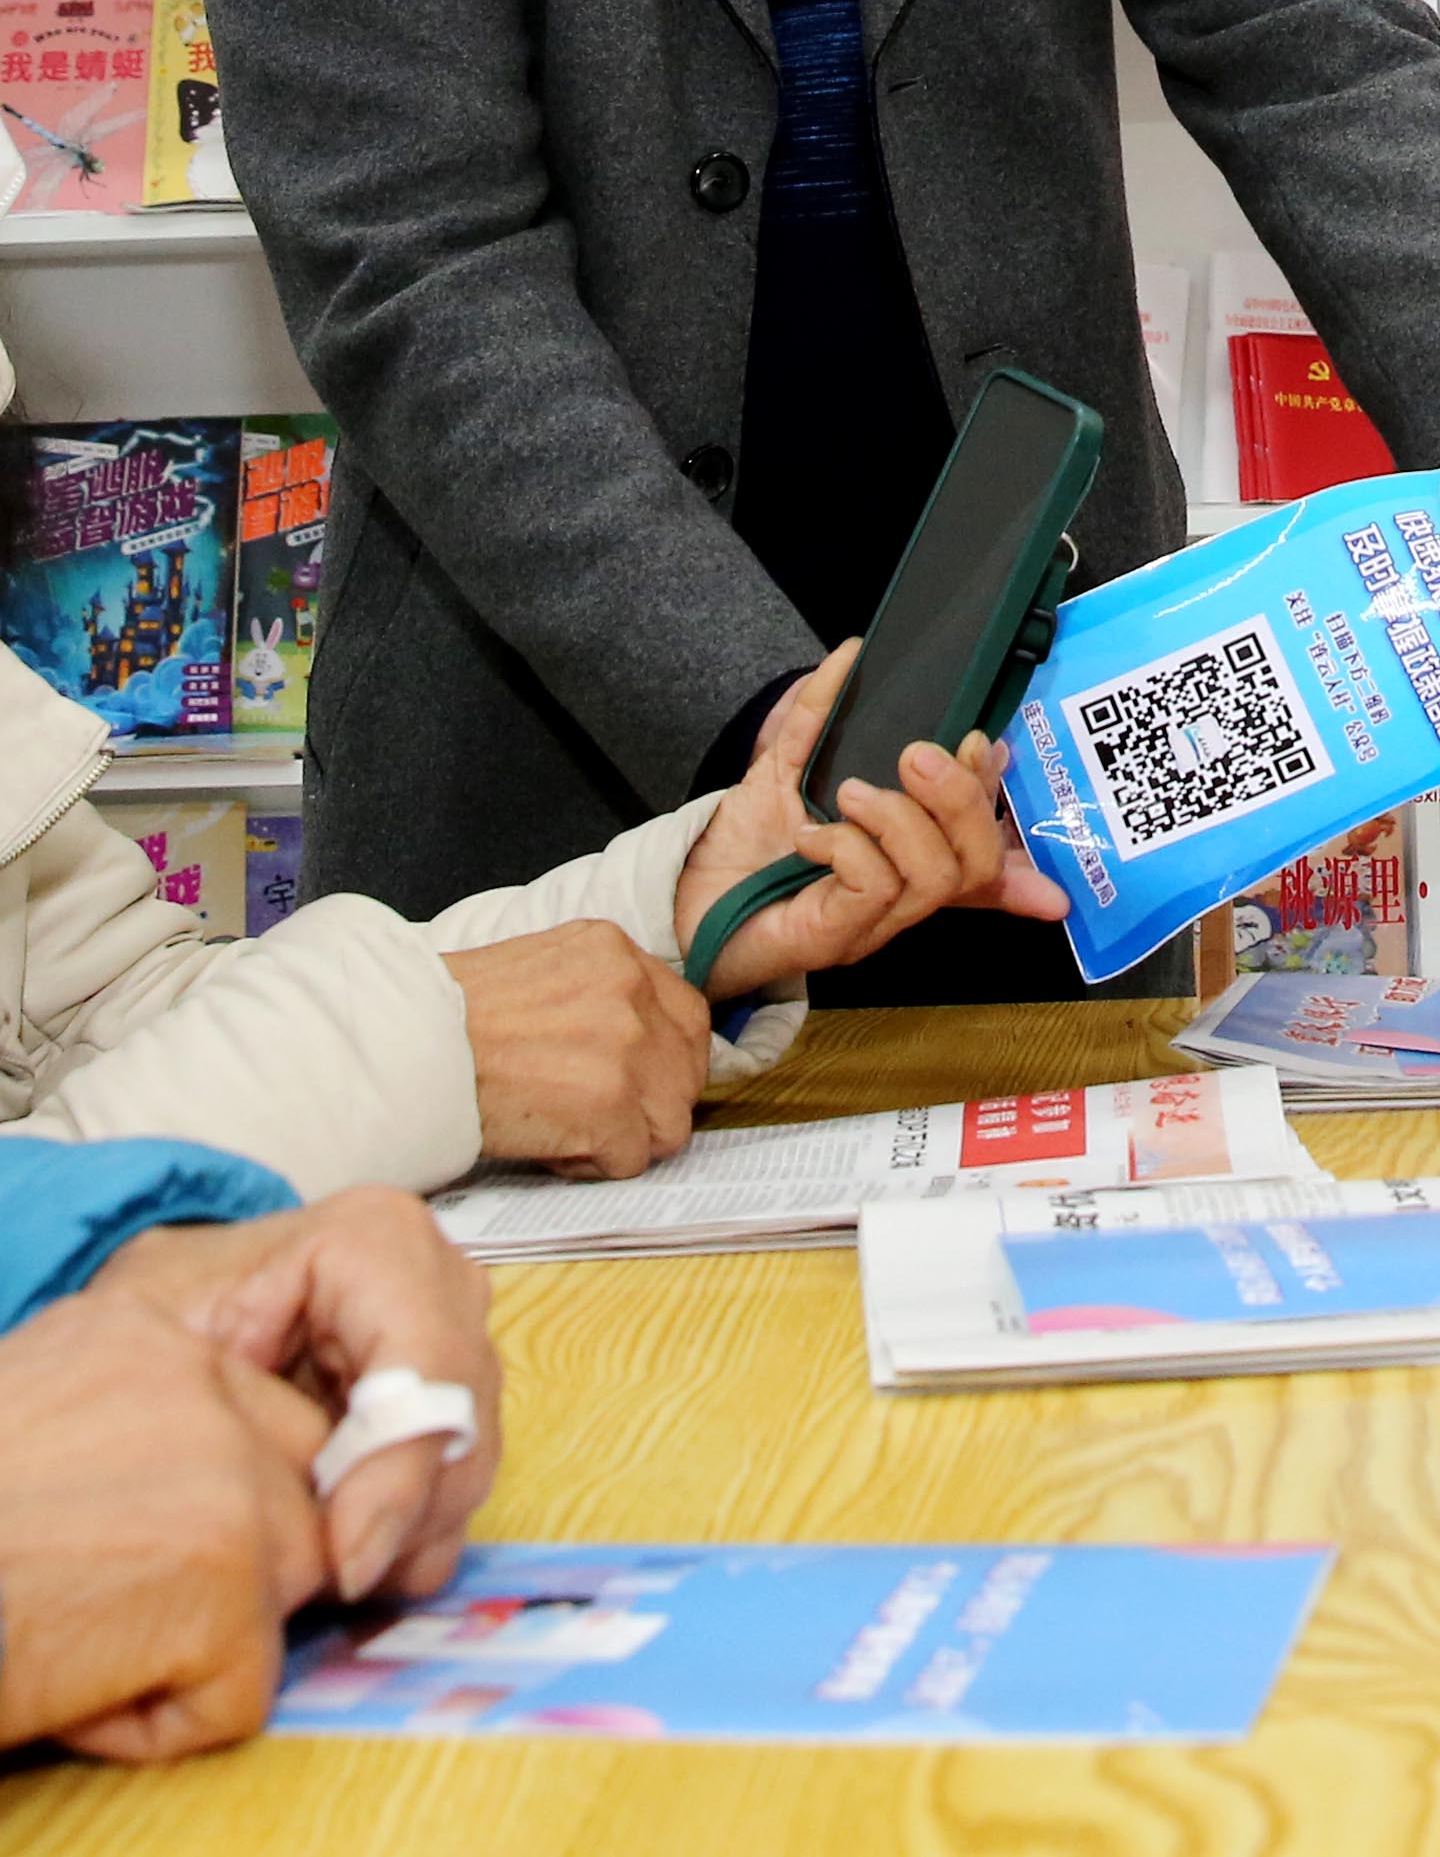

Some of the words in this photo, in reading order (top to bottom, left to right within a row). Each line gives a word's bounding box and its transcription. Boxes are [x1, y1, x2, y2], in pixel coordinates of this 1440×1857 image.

[1, 49, 145, 82] 我是蜻蜓
[1275, 392, 1362, 412] 中国共产党章
[1324, 612, 1392, 725] 扫描下方二维码
[264, 874, 295, 913] 宇
